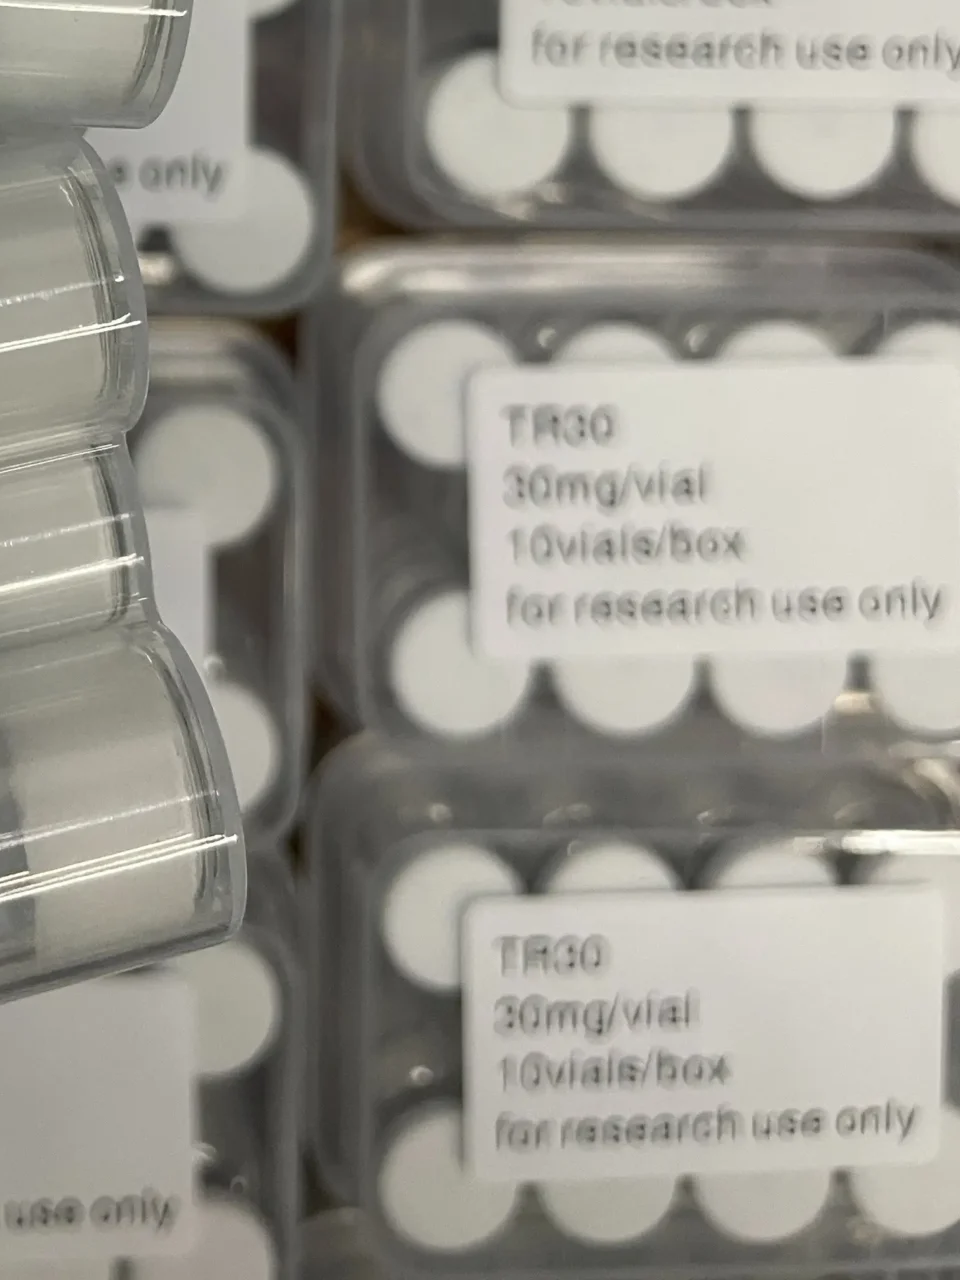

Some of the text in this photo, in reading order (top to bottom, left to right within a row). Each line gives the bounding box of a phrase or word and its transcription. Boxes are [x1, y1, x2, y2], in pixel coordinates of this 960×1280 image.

[530, 27, 592, 69] for
[598, 26, 788, 69] research
[795, 32, 877, 71] use
[139, 148, 230, 204] only
[499, 402, 620, 449] TR30
[501, 458, 718, 516] 30mg/vial
[504, 520, 751, 566] 10vials/box
[503, 575, 950, 630] for research use only
[491, 933, 614, 978] TR30
[492, 986, 701, 1043] 30mg/vial
[494, 1045, 735, 1094] 10vials/box
[494, 1096, 926, 1152] for research use only
[90, 1185, 182, 1236] only
